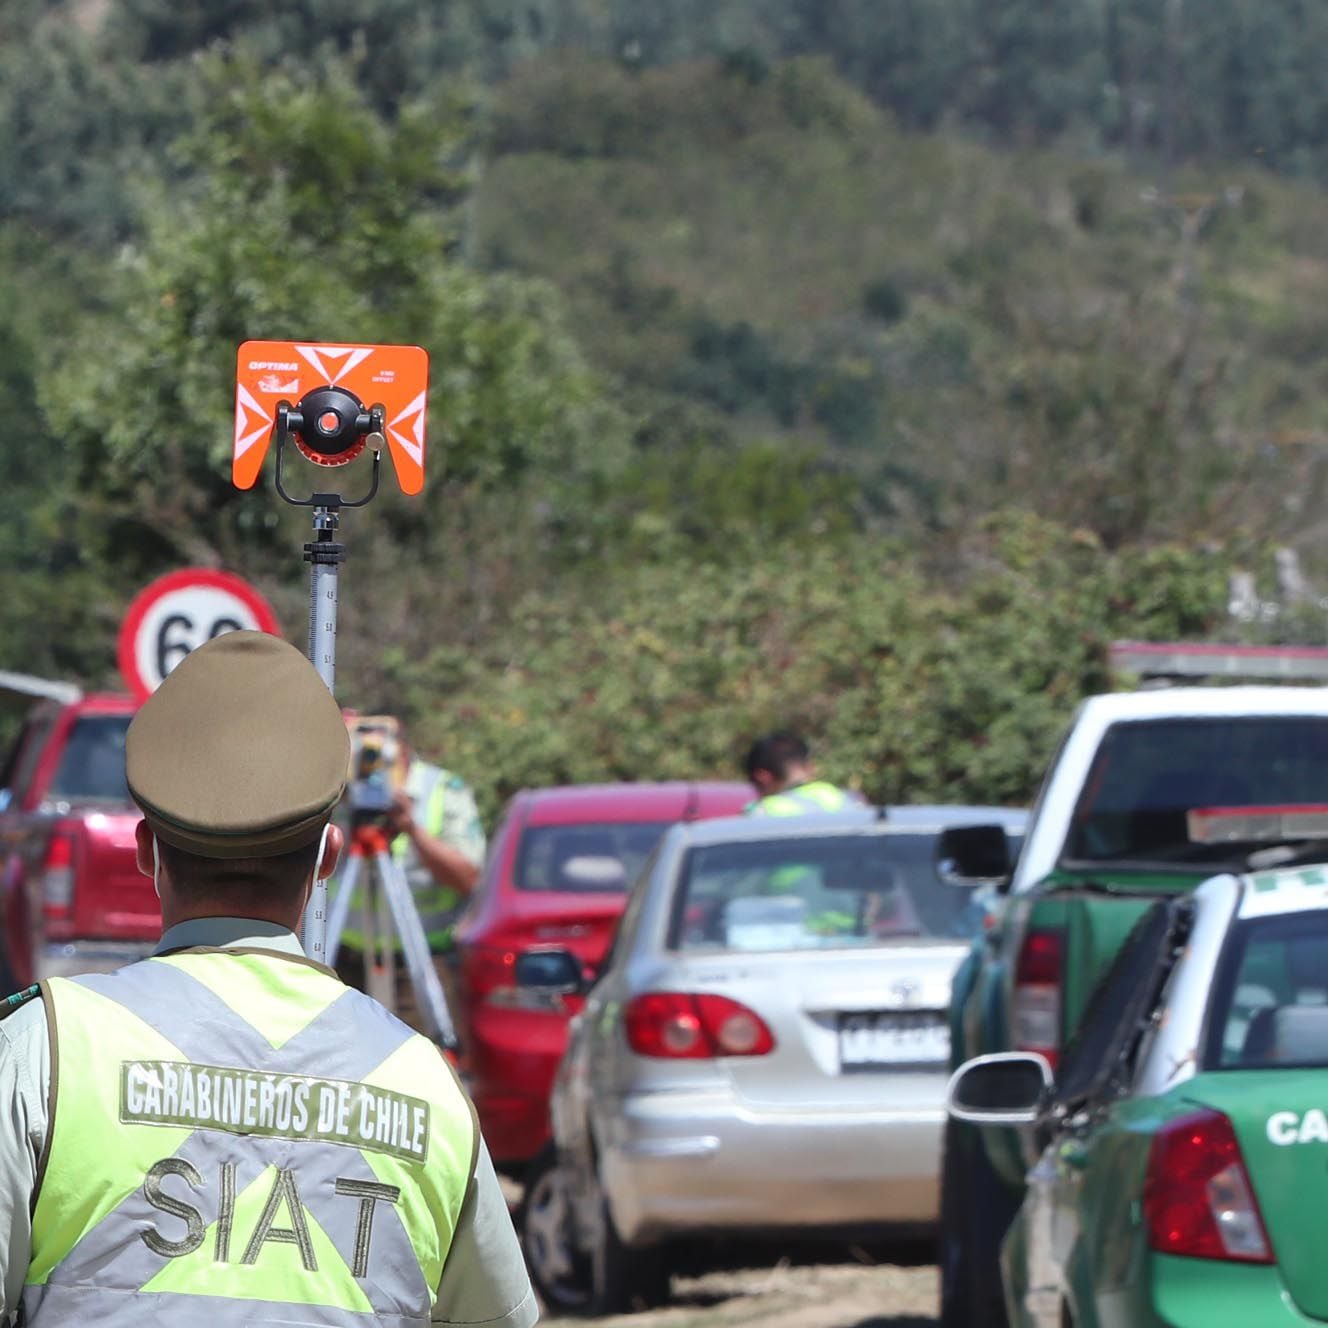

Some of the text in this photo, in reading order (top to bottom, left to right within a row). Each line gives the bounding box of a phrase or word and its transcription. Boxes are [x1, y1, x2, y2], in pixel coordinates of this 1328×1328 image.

[248, 361, 299, 372] OPTIMA
[157, 615, 243, 679] 6
[127, 1063, 426, 1154] CARABINEROS DE CHILE
[140, 1157, 400, 1278] SIAT
